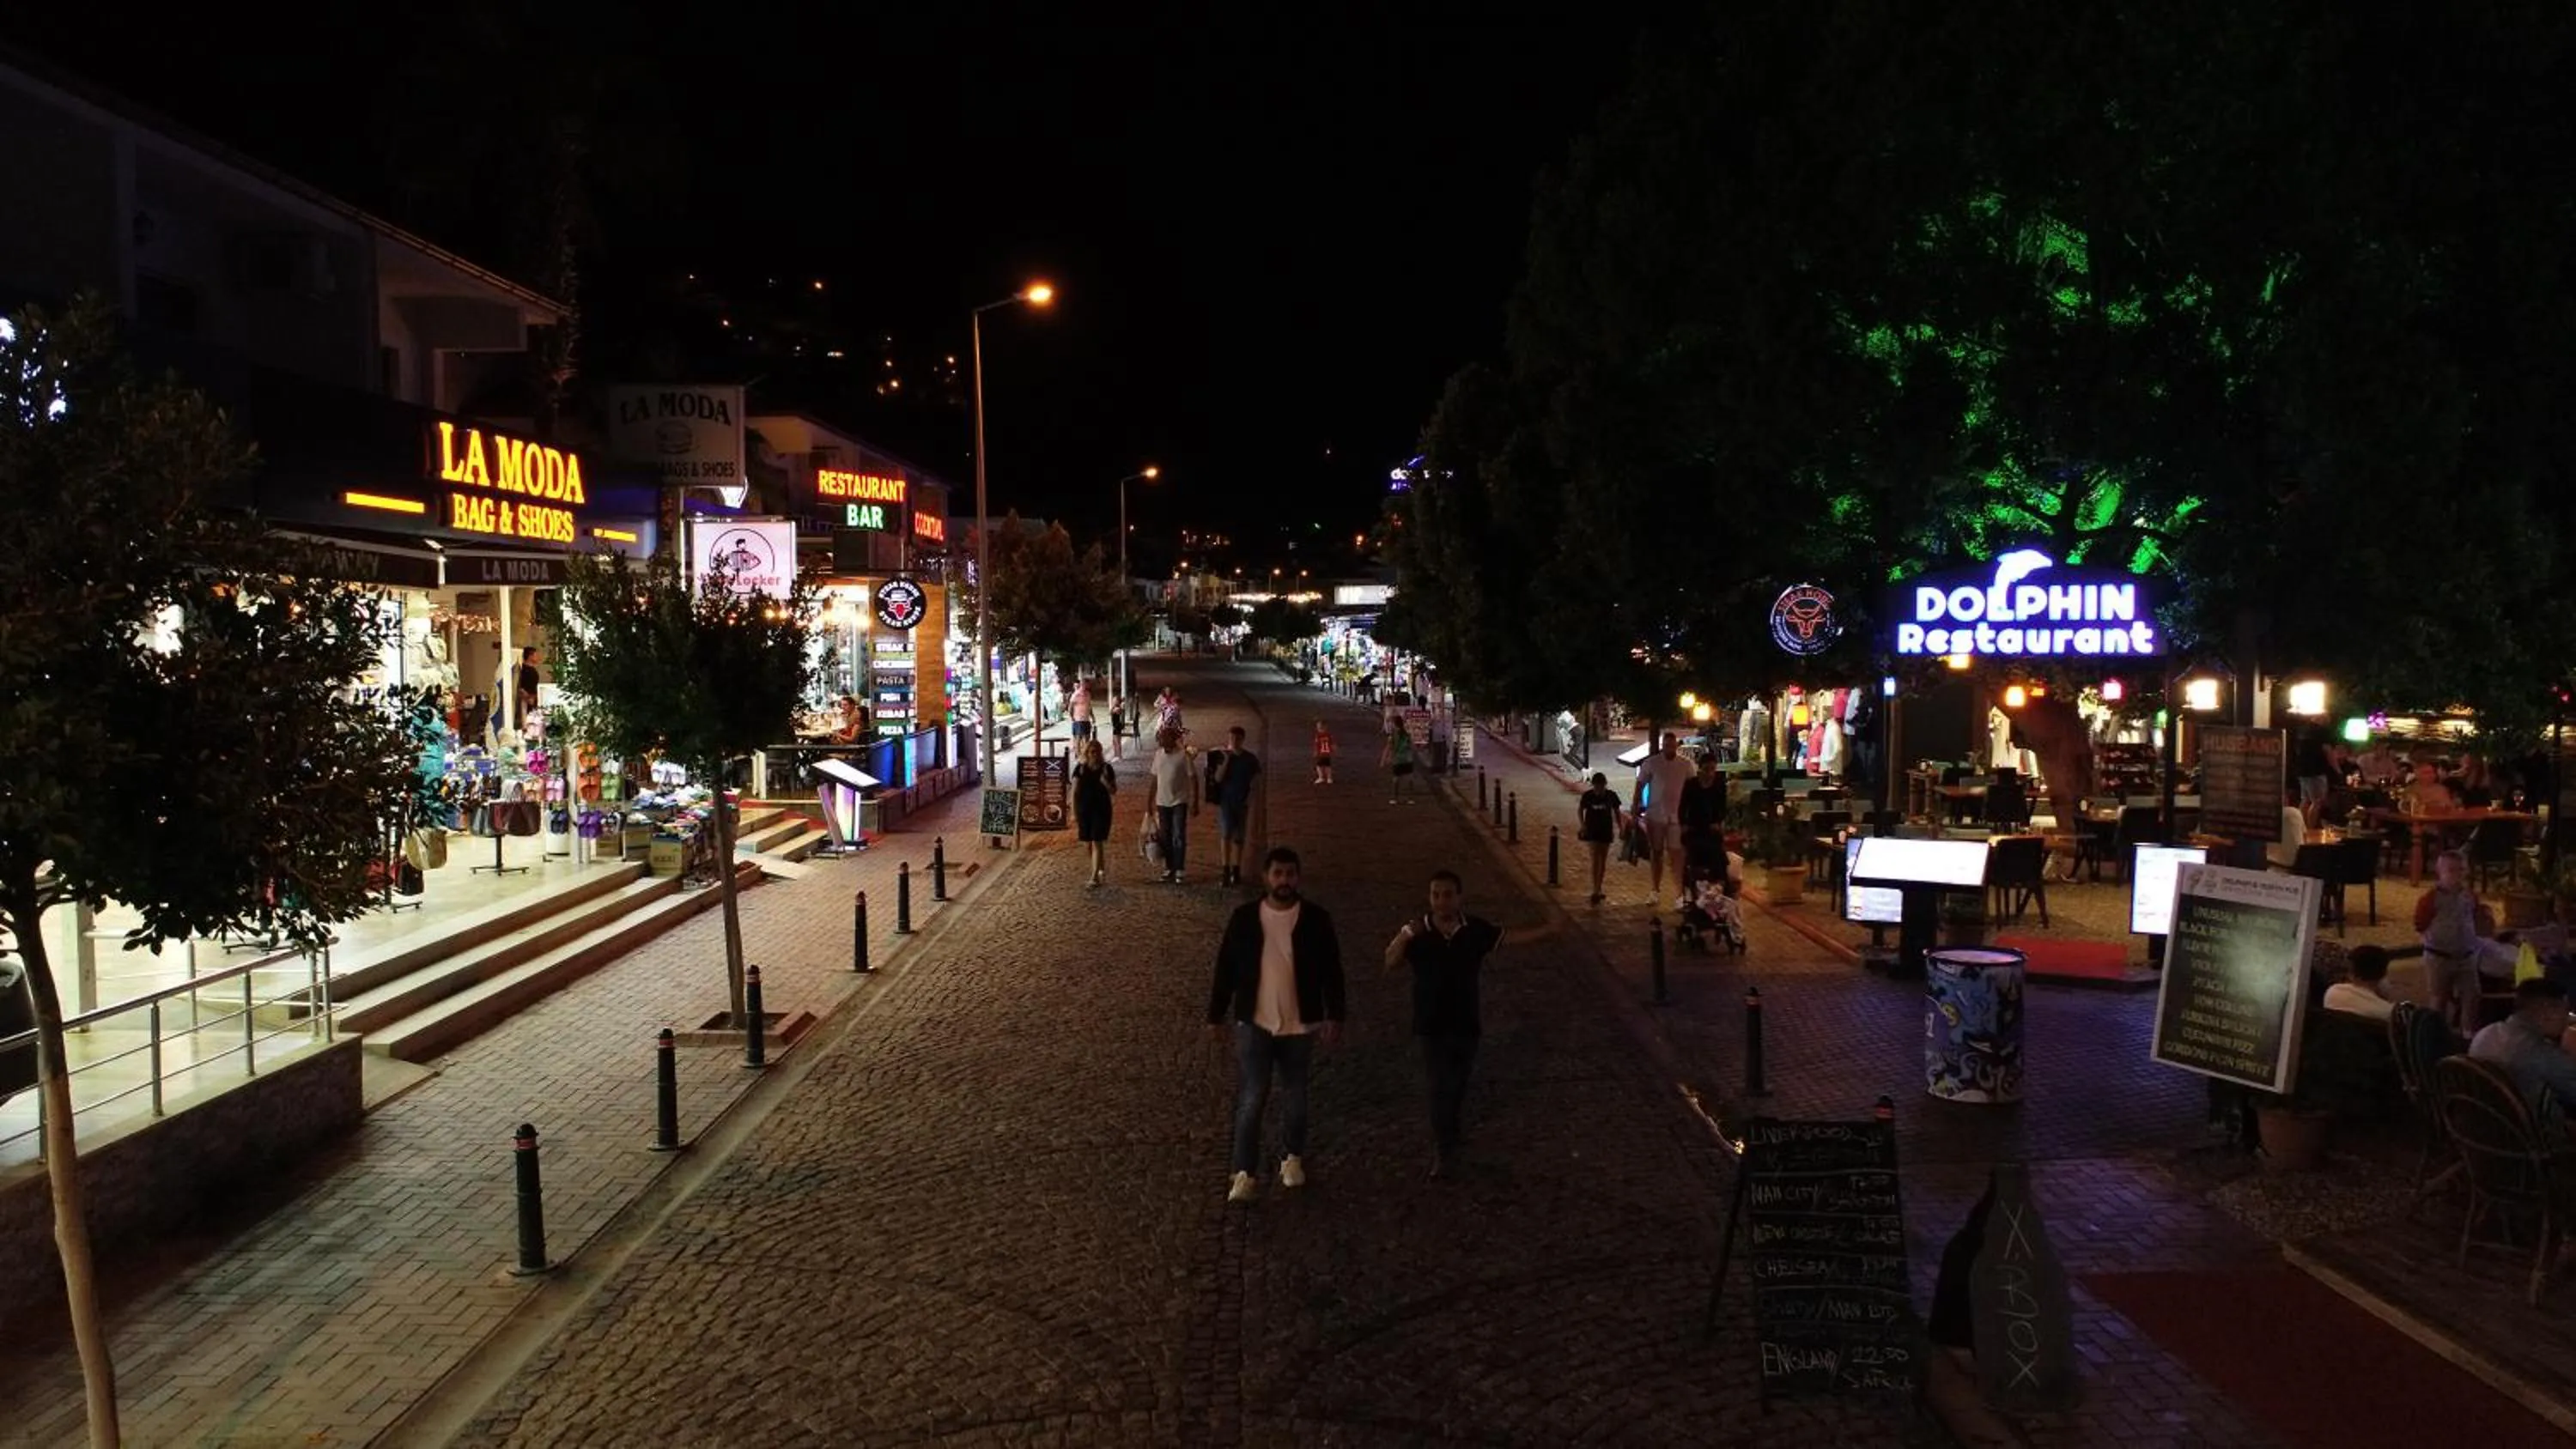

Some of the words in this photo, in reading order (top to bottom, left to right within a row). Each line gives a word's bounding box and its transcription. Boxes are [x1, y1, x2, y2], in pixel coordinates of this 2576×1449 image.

[620, 395, 651, 425] LA
[659, 392, 732, 427] MODA
[439, 421, 490, 487] LA
[495, 435, 586, 504] MODA
[817, 470, 907, 502] RESTAURANT
[453, 493, 495, 533] BAG
[500, 500, 514, 535] &
[518, 503, 575, 543] SHOES
[846, 503, 884, 530] BAR
[481, 561, 502, 581] LA
[507, 561, 550, 581] MODA
[736, 574, 781, 586] Locker
[1915, 583, 2136, 622] DOLPHIN
[1897, 621, 2155, 654] Restaurant
[876, 676, 905, 685] PASTA
